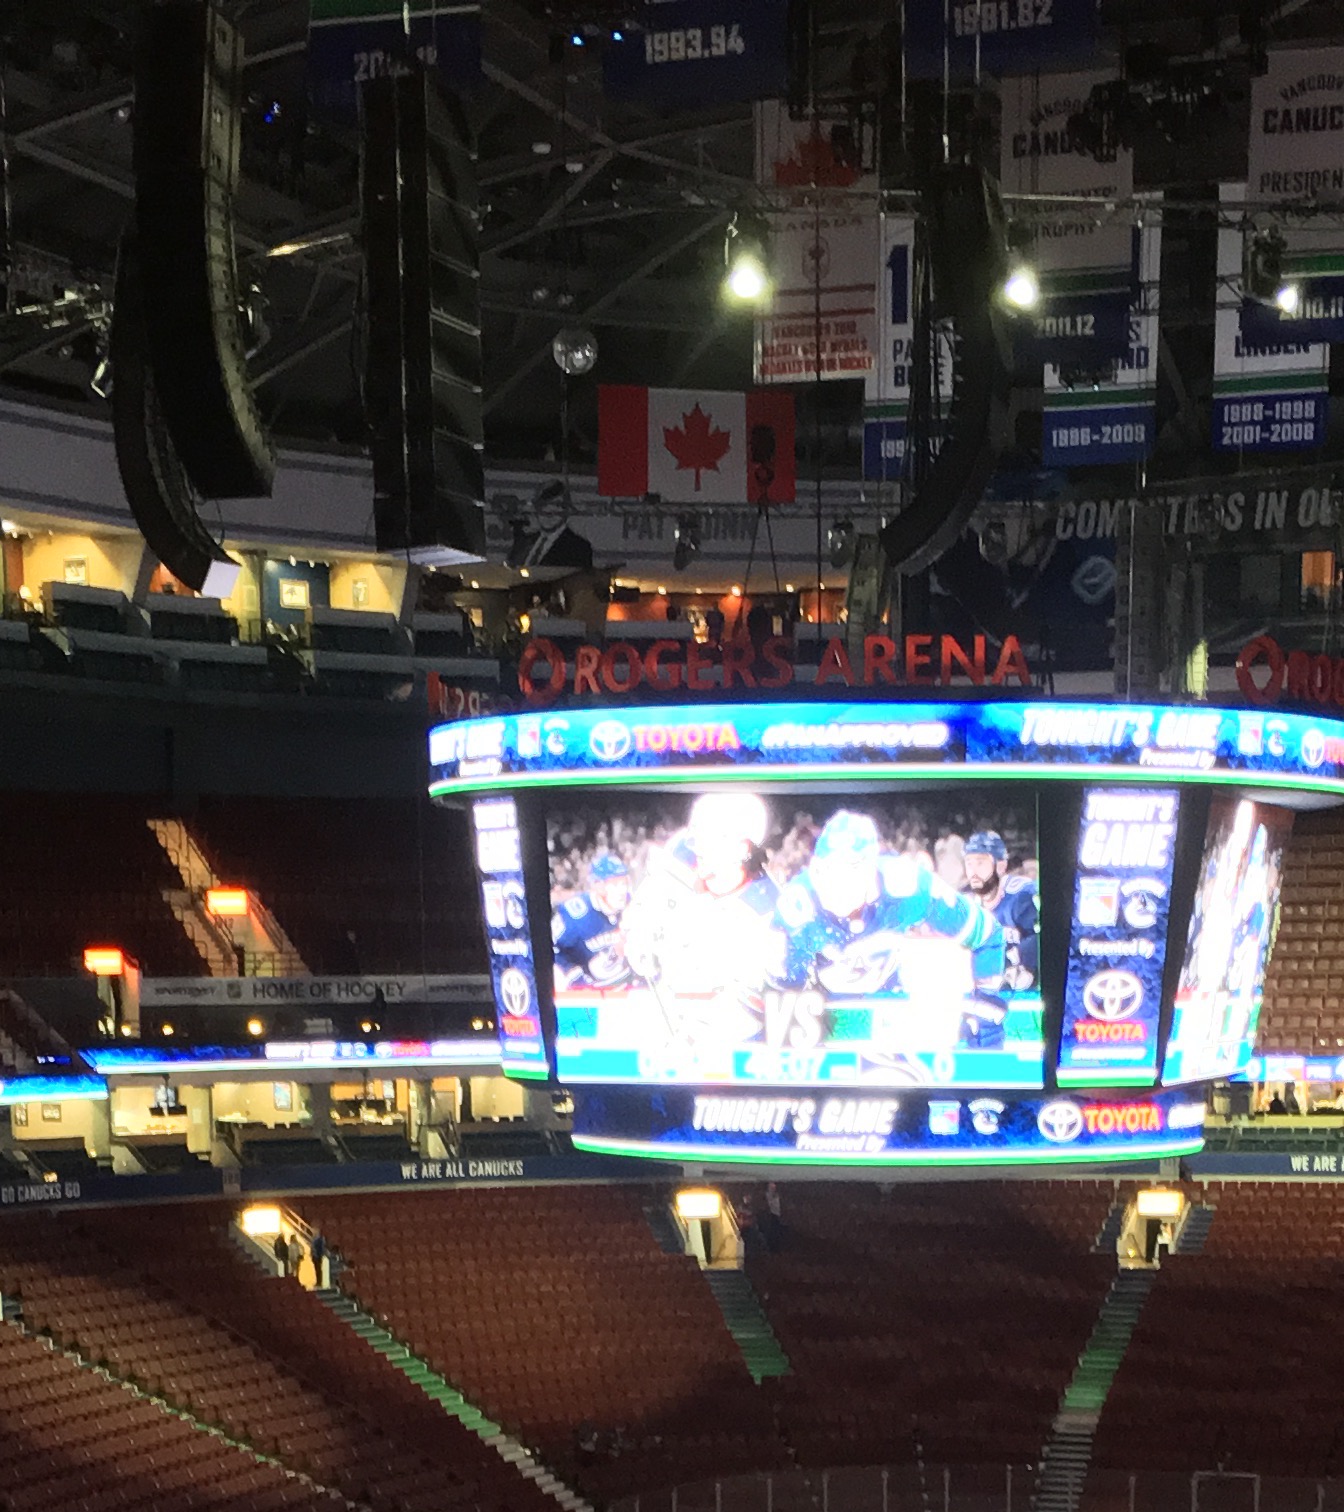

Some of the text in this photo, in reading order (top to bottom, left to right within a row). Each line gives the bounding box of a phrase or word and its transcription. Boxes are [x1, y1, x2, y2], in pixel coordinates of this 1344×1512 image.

[644, 23, 746, 64] 1993.94
[573, 633, 1034, 697] ROGERS ARENA
[632, 723, 741, 752] TOYOTA
[1020, 709, 1222, 750] TONIGHT'S GAME
[1080, 822, 1174, 869] GAME
[1078, 938, 1137, 957] Presented
[252, 982, 305, 999] HOME
[310, 982, 333, 999] OF
[336, 981, 407, 999] HOCKEY
[763, 990, 826, 1049] VS
[1074, 1019, 1147, 1043] TOYOTA
[691, 1096, 899, 1137] TONIGHT'S GAME
[1083, 1105, 1164, 1133] TOYOTA
[795, 1133, 865, 1152] Presented
[400, 1159, 525, 1180] WE ARE ALL CANUCKS
[1290, 1156, 1311, 1173] WE
[1314, 1156, 1338, 1173] ARE
[17, 1183, 62, 1202] CANUCKS
